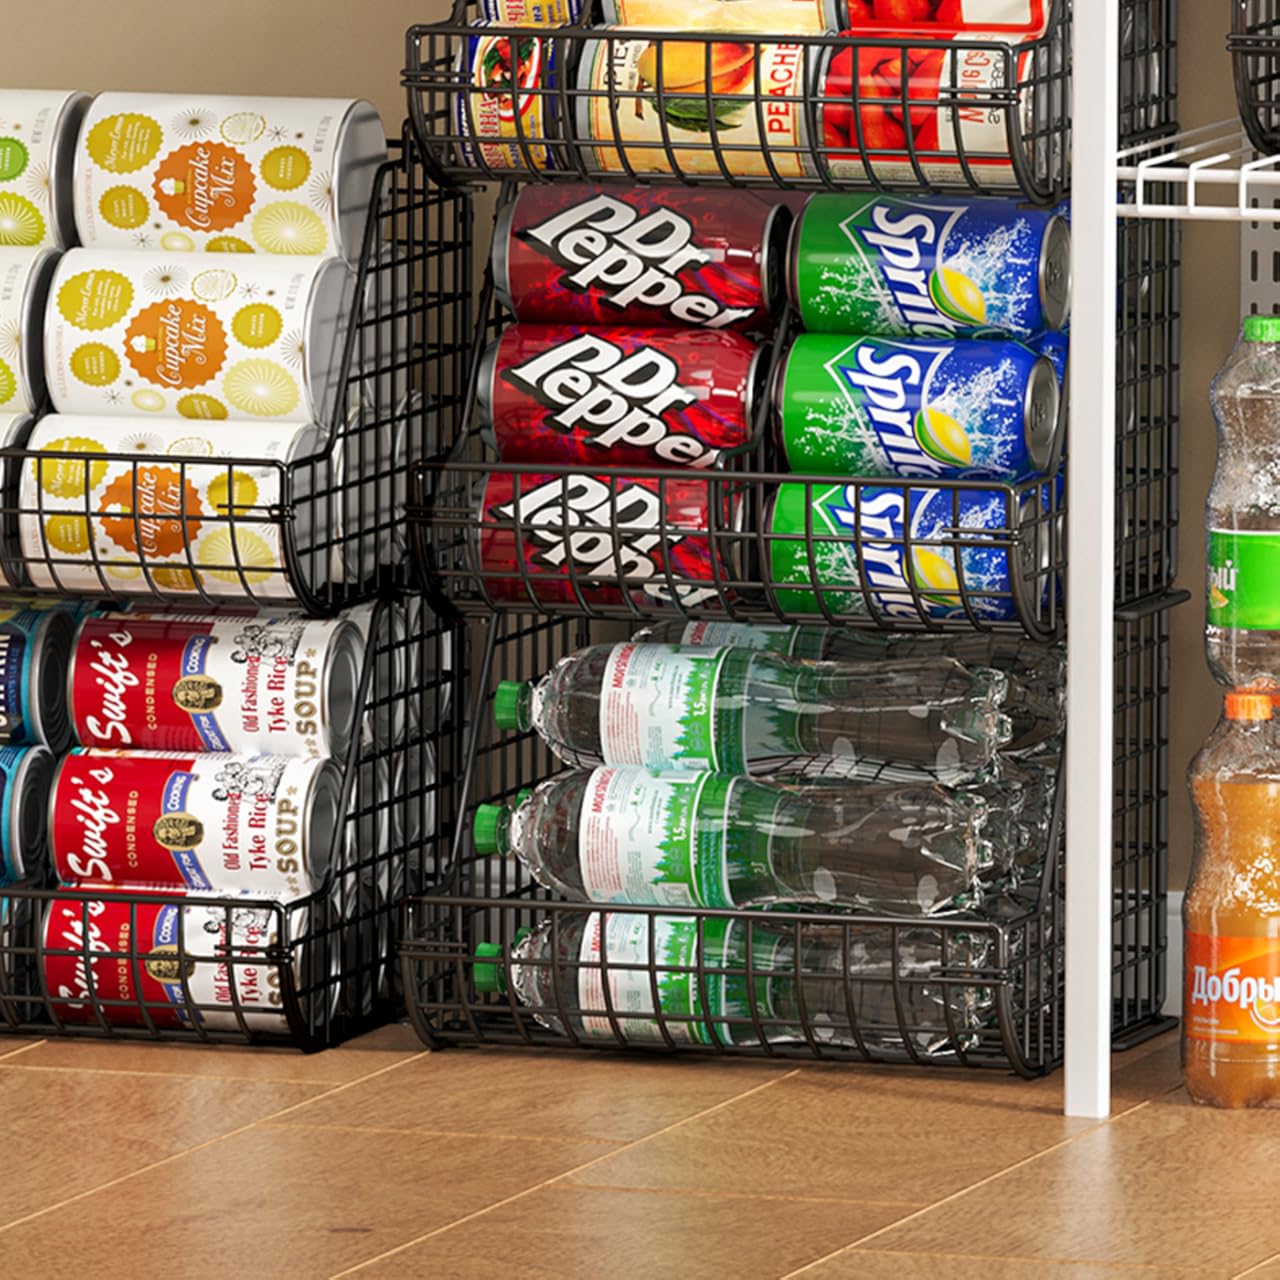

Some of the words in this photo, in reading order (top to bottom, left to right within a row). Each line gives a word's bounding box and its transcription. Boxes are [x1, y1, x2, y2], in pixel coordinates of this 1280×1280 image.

[185, 146, 213, 229] Cupcake
[209, 155, 237, 208] Mix
[526, 193, 756, 330] Pepper
[625, 206, 712, 276] Dr
[862, 204, 958, 338] Sprite
[156, 302, 183, 386] Cupcake
[181, 313, 209, 366] Mix
[609, 346, 700, 417] Dr
[186, 635, 207, 674] COOKING
[240, 655, 262, 712] Fashioned
[267, 655, 289, 693] Rice
[86, 628, 140, 745] Swift's
[145, 652, 159, 732] CONDENSED
[267, 696, 289, 735] Tyke
[293, 659, 319, 737] SOUP
[241, 714, 261, 733] Old
[67, 765, 121, 882] Swift's
[126, 789, 140, 868] CONDENSED
[221, 793, 242, 850] Fashioned
[247, 792, 270, 830] Rice
[274, 796, 300, 874] SOUP
[223, 852, 241, 872] Old
[247, 833, 270, 872] Tyke
[240, 966, 260, 1005] Tyke
